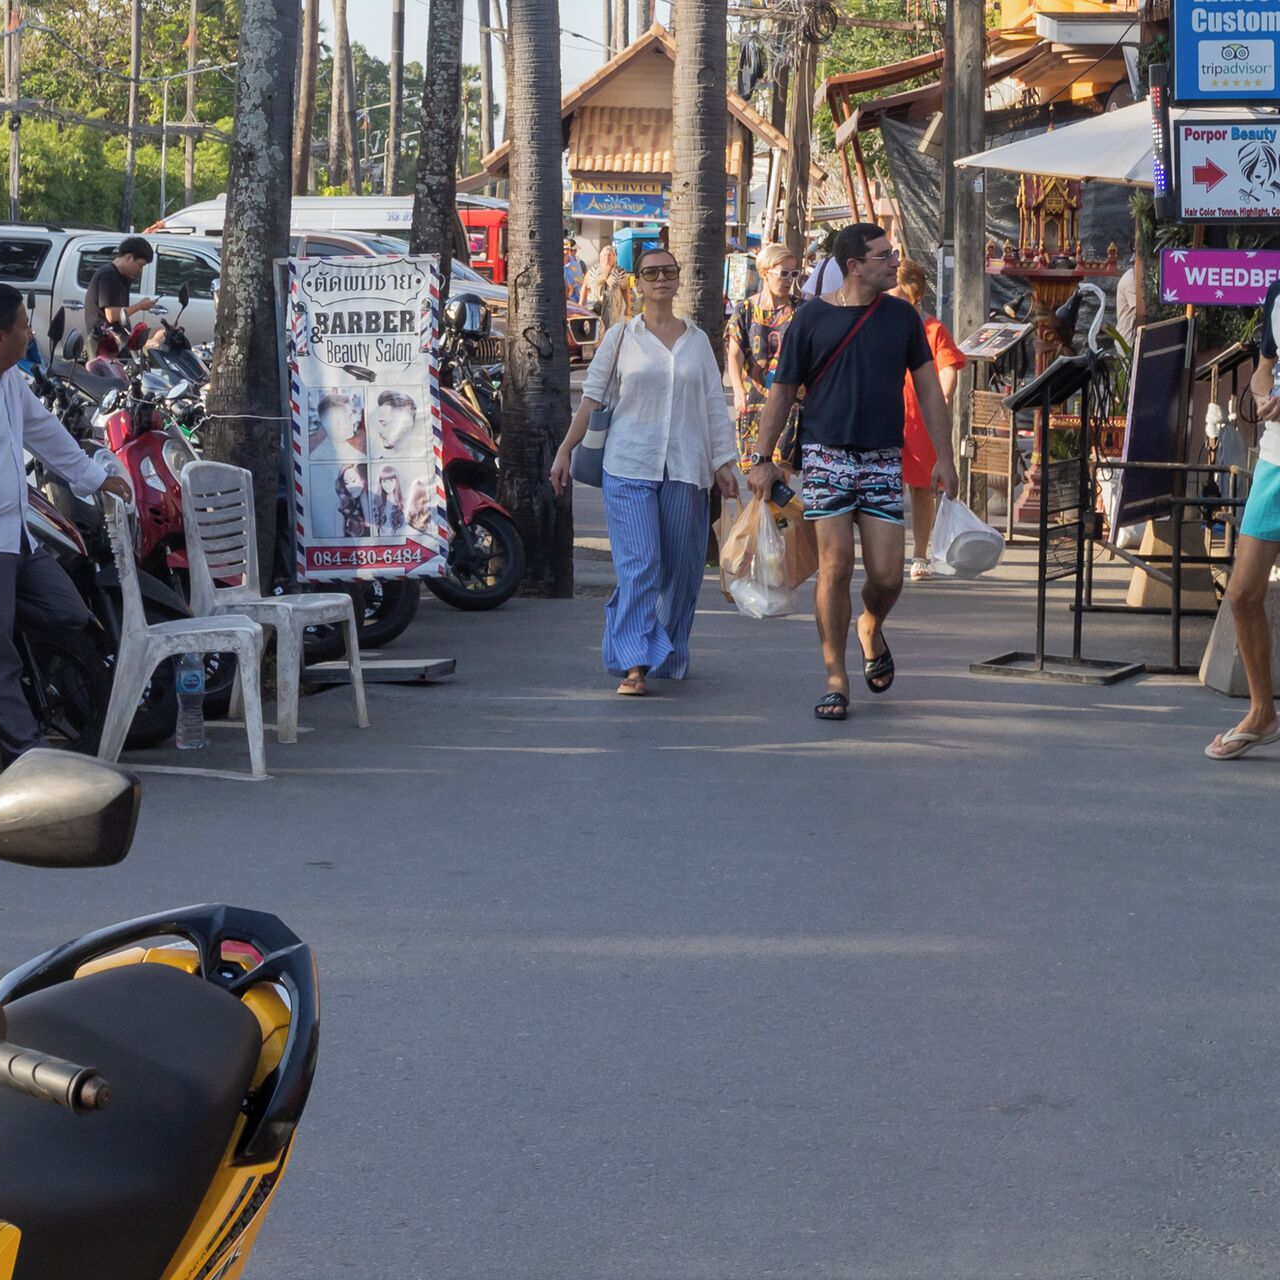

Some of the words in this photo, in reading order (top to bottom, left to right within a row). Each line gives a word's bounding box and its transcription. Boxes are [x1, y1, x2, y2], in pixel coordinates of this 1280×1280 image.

[1201, 62, 1268, 77] tripadvisor
[1184, 127, 1228, 144] Porpor
[1231, 127, 1277, 143] Beauty
[607, 182, 659, 193] SERVICE
[1184, 207, 1198, 217] Hair
[1199, 207, 1216, 217] Color
[314, 271, 413, 292] ตัดผมชาย
[314, 310, 416, 334] BARBER
[310, 326, 324, 344] &
[326, 339, 370, 366] Beauty
[375, 338, 412, 363] Salon
[313, 548, 422, 566] 084-430-6484
